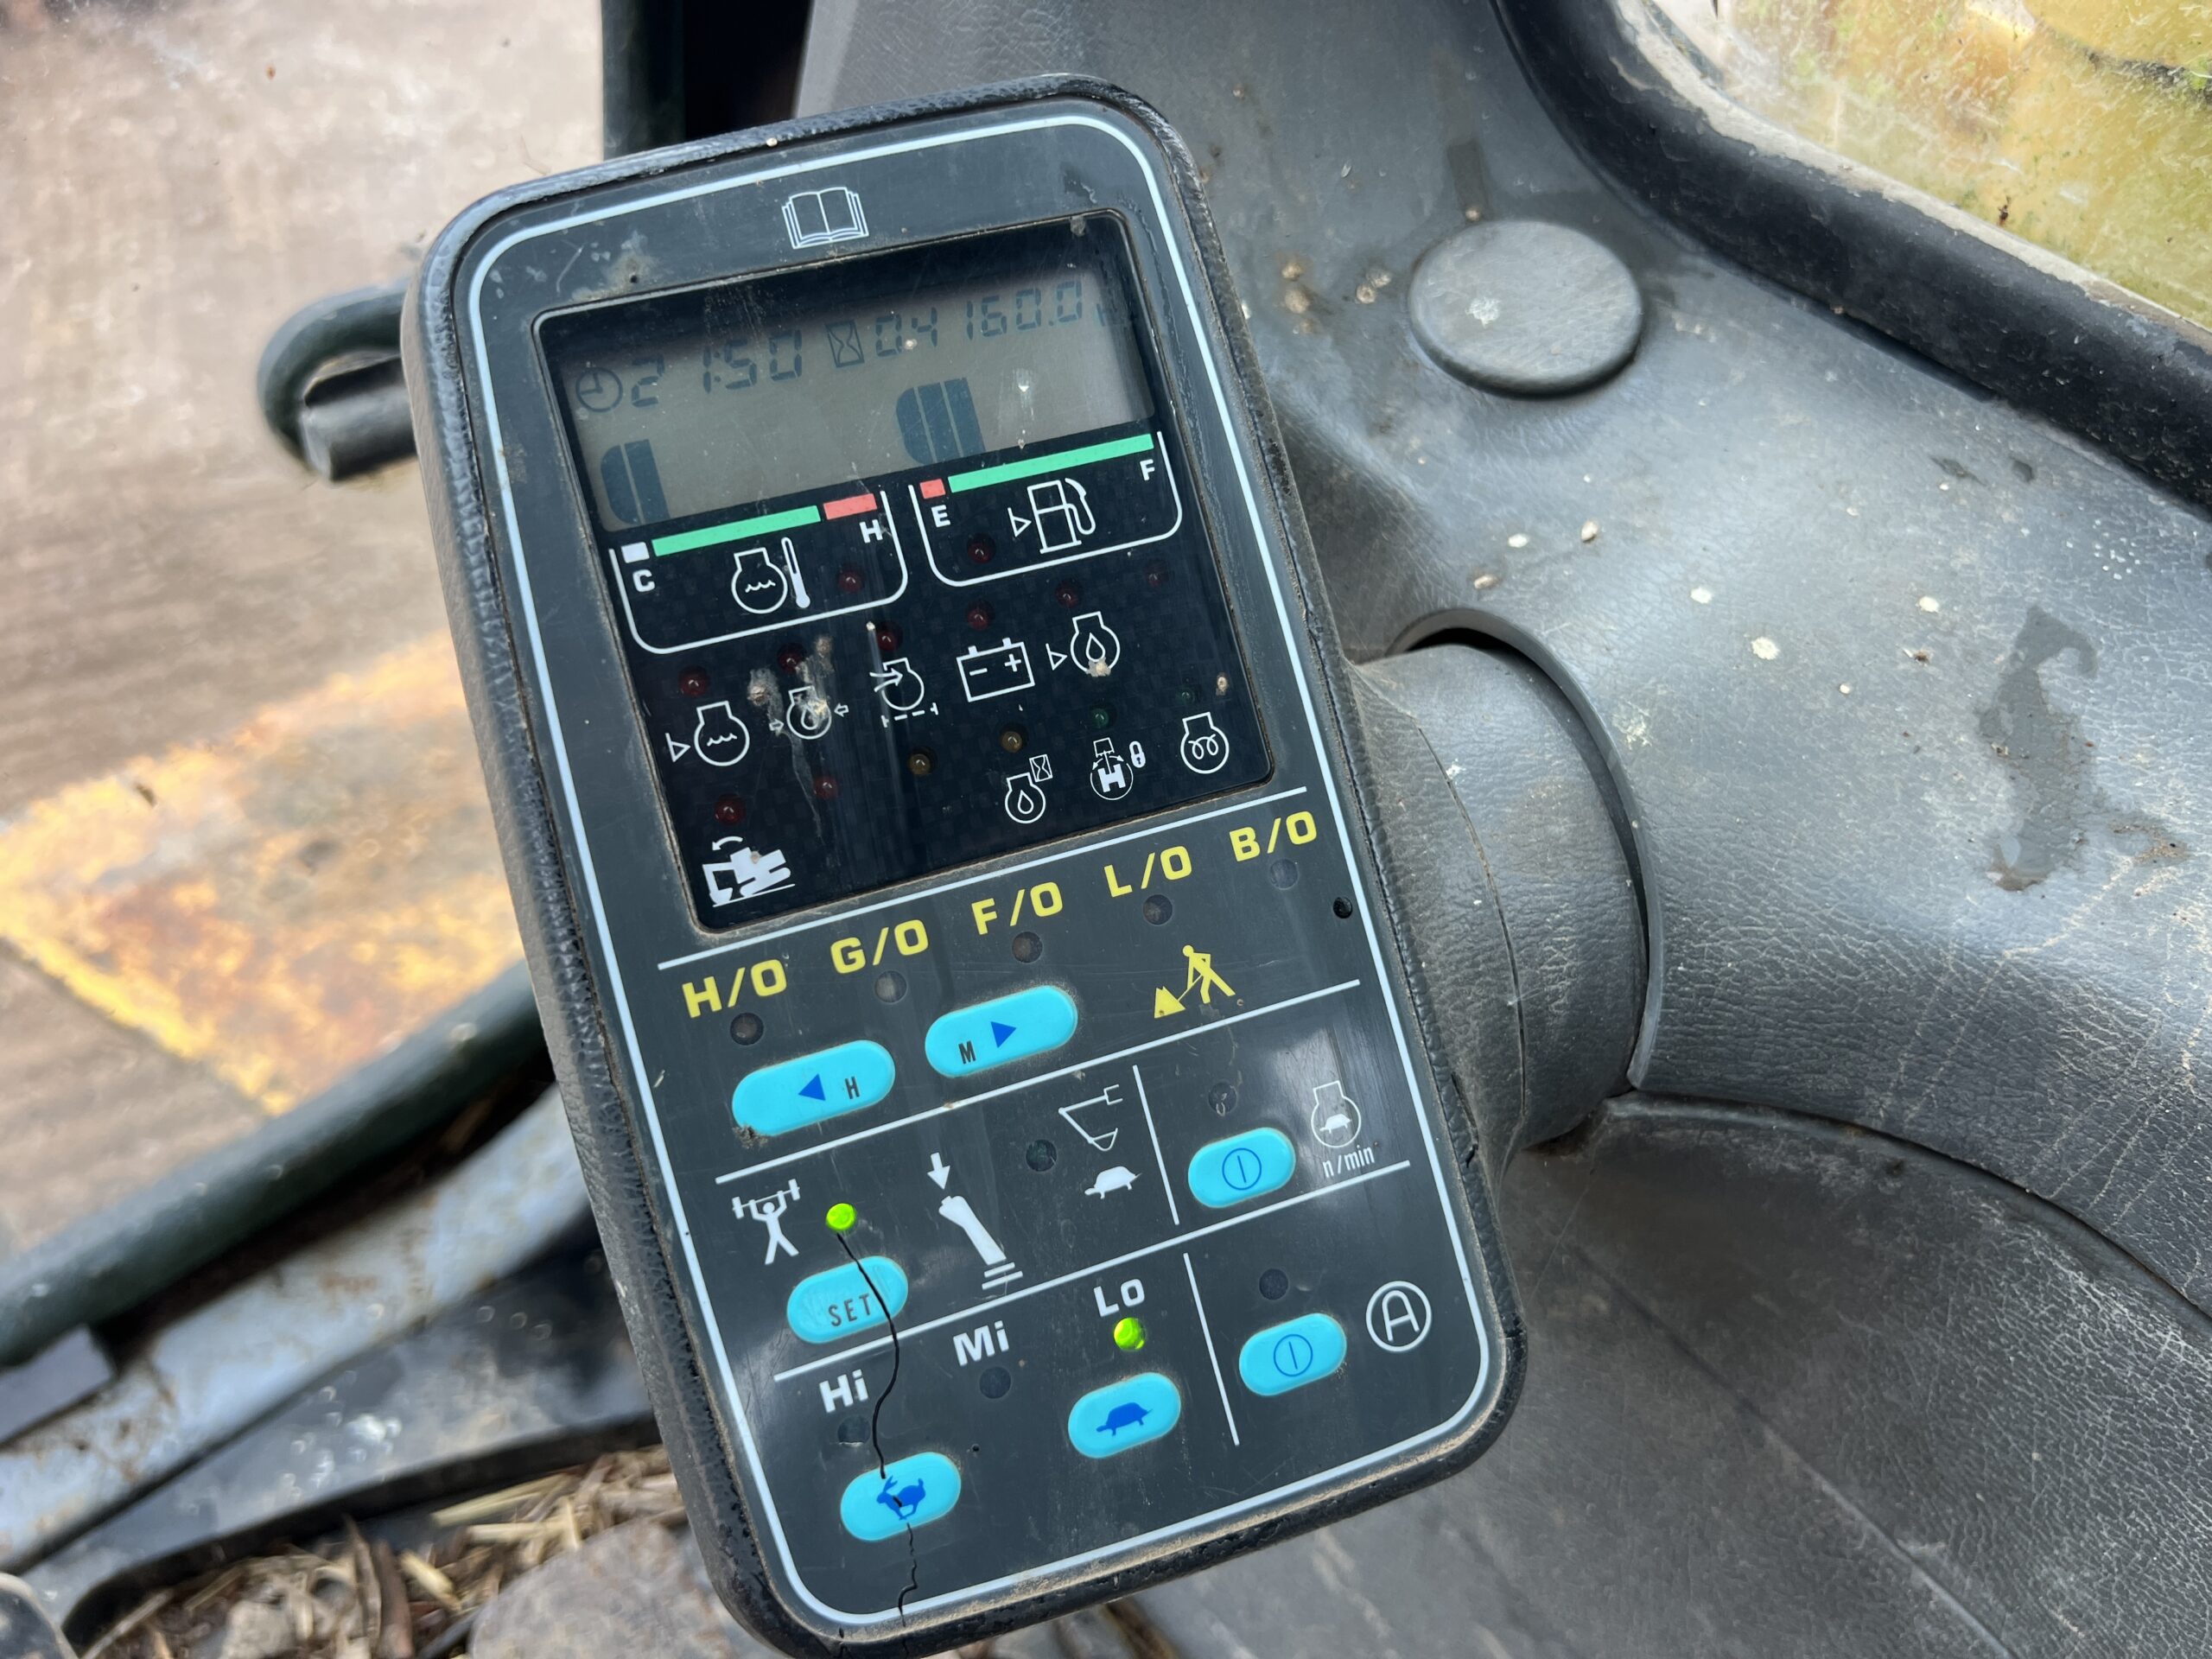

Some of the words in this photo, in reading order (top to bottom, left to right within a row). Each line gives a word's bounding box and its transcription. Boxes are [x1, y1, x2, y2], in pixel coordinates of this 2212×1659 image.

[1141, 460, 1155, 481] F
[860, 521, 883, 543] H
[931, 505, 950, 527] E
[634, 569, 655, 592] C
[1229, 810, 1318, 861] B/O
[1103, 846, 1192, 897] L/O
[972, 881, 1063, 935] F/O
[831, 919, 928, 975] G/O
[683, 959, 787, 1017] H/O
[958, 1040, 976, 1064] M
[843, 1077, 860, 1099] H
[1322, 1144, 1375, 1177] n/min
[828, 1294, 871, 1327] SET
[953, 1321, 1009, 1367] Mi
[819, 1369, 869, 1413] Hi
